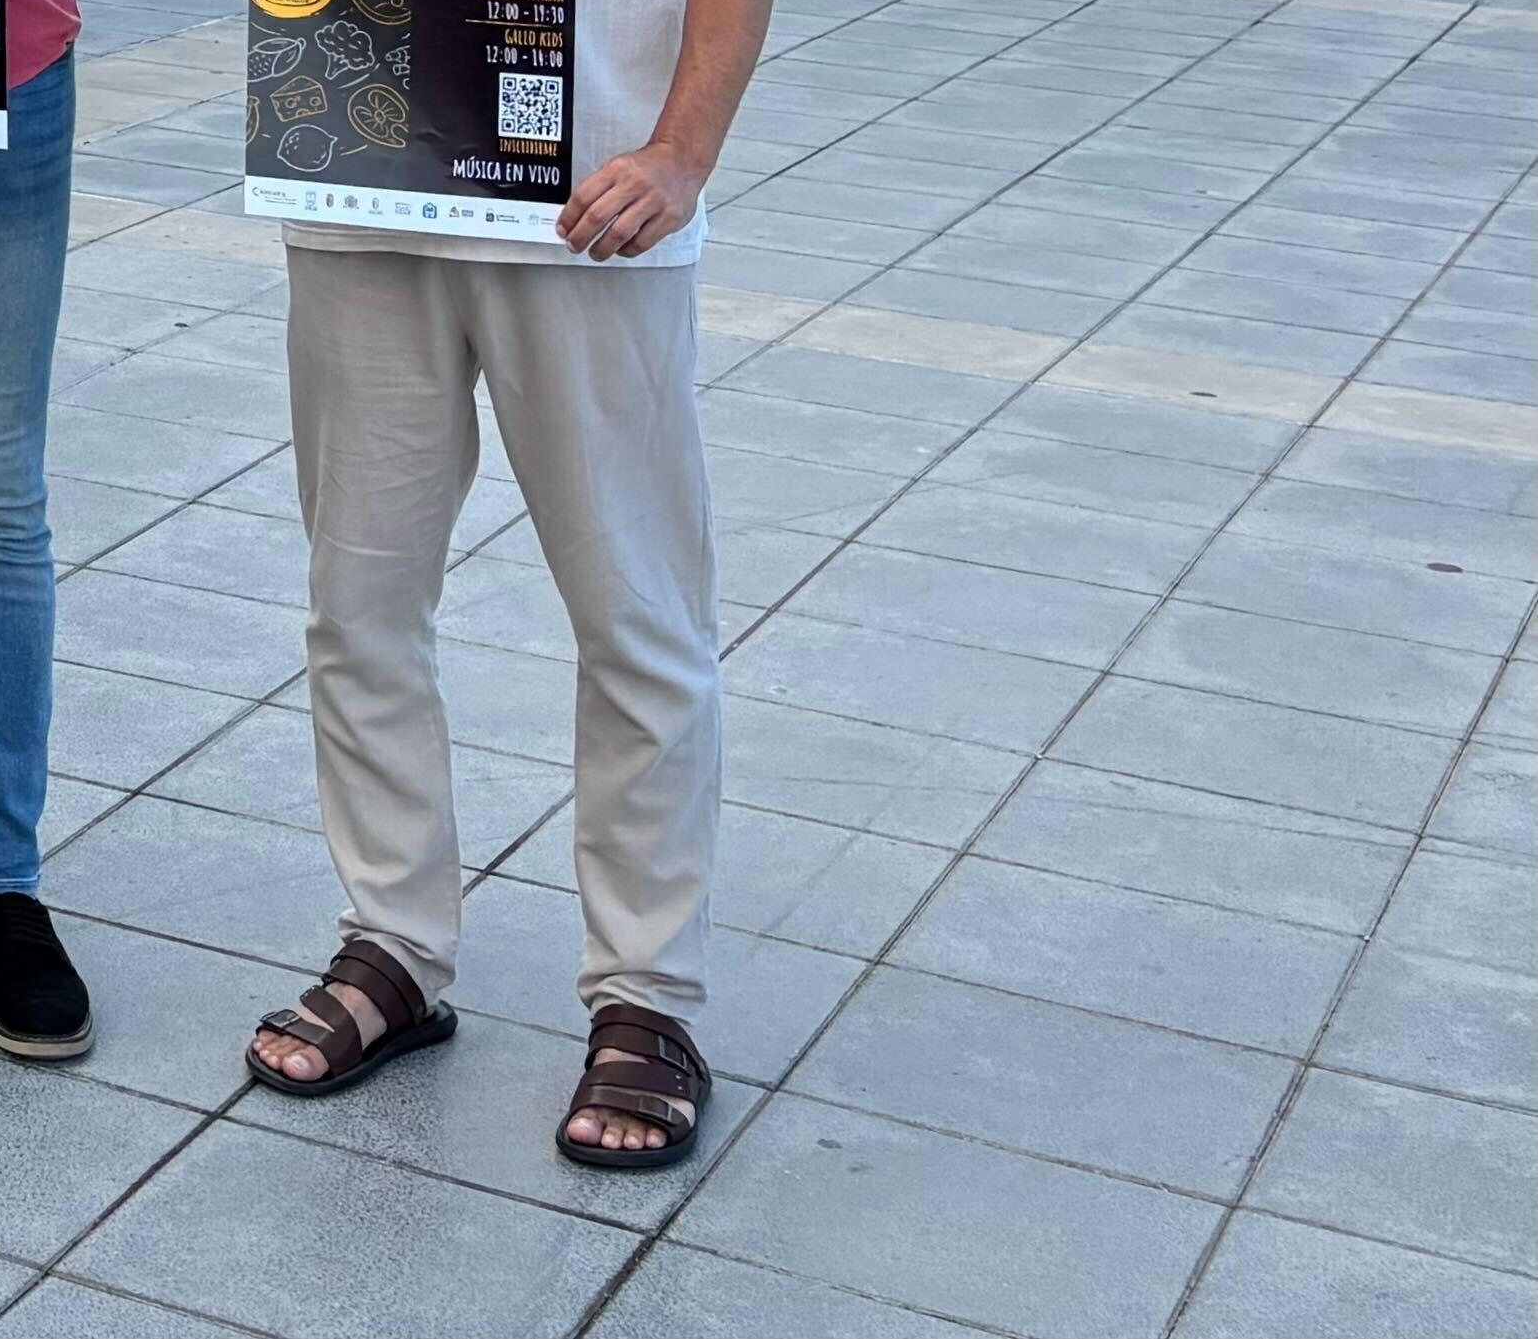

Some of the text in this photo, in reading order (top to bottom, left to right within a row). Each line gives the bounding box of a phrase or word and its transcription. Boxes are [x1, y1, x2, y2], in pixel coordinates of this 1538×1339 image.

[488, 0, 519, 20] 12:00
[534, 4, 563, 23] 19:30
[505, 28, 562, 47] GALLO KIDS
[453, 156, 560, 185] MÚSICA EN VIVO
